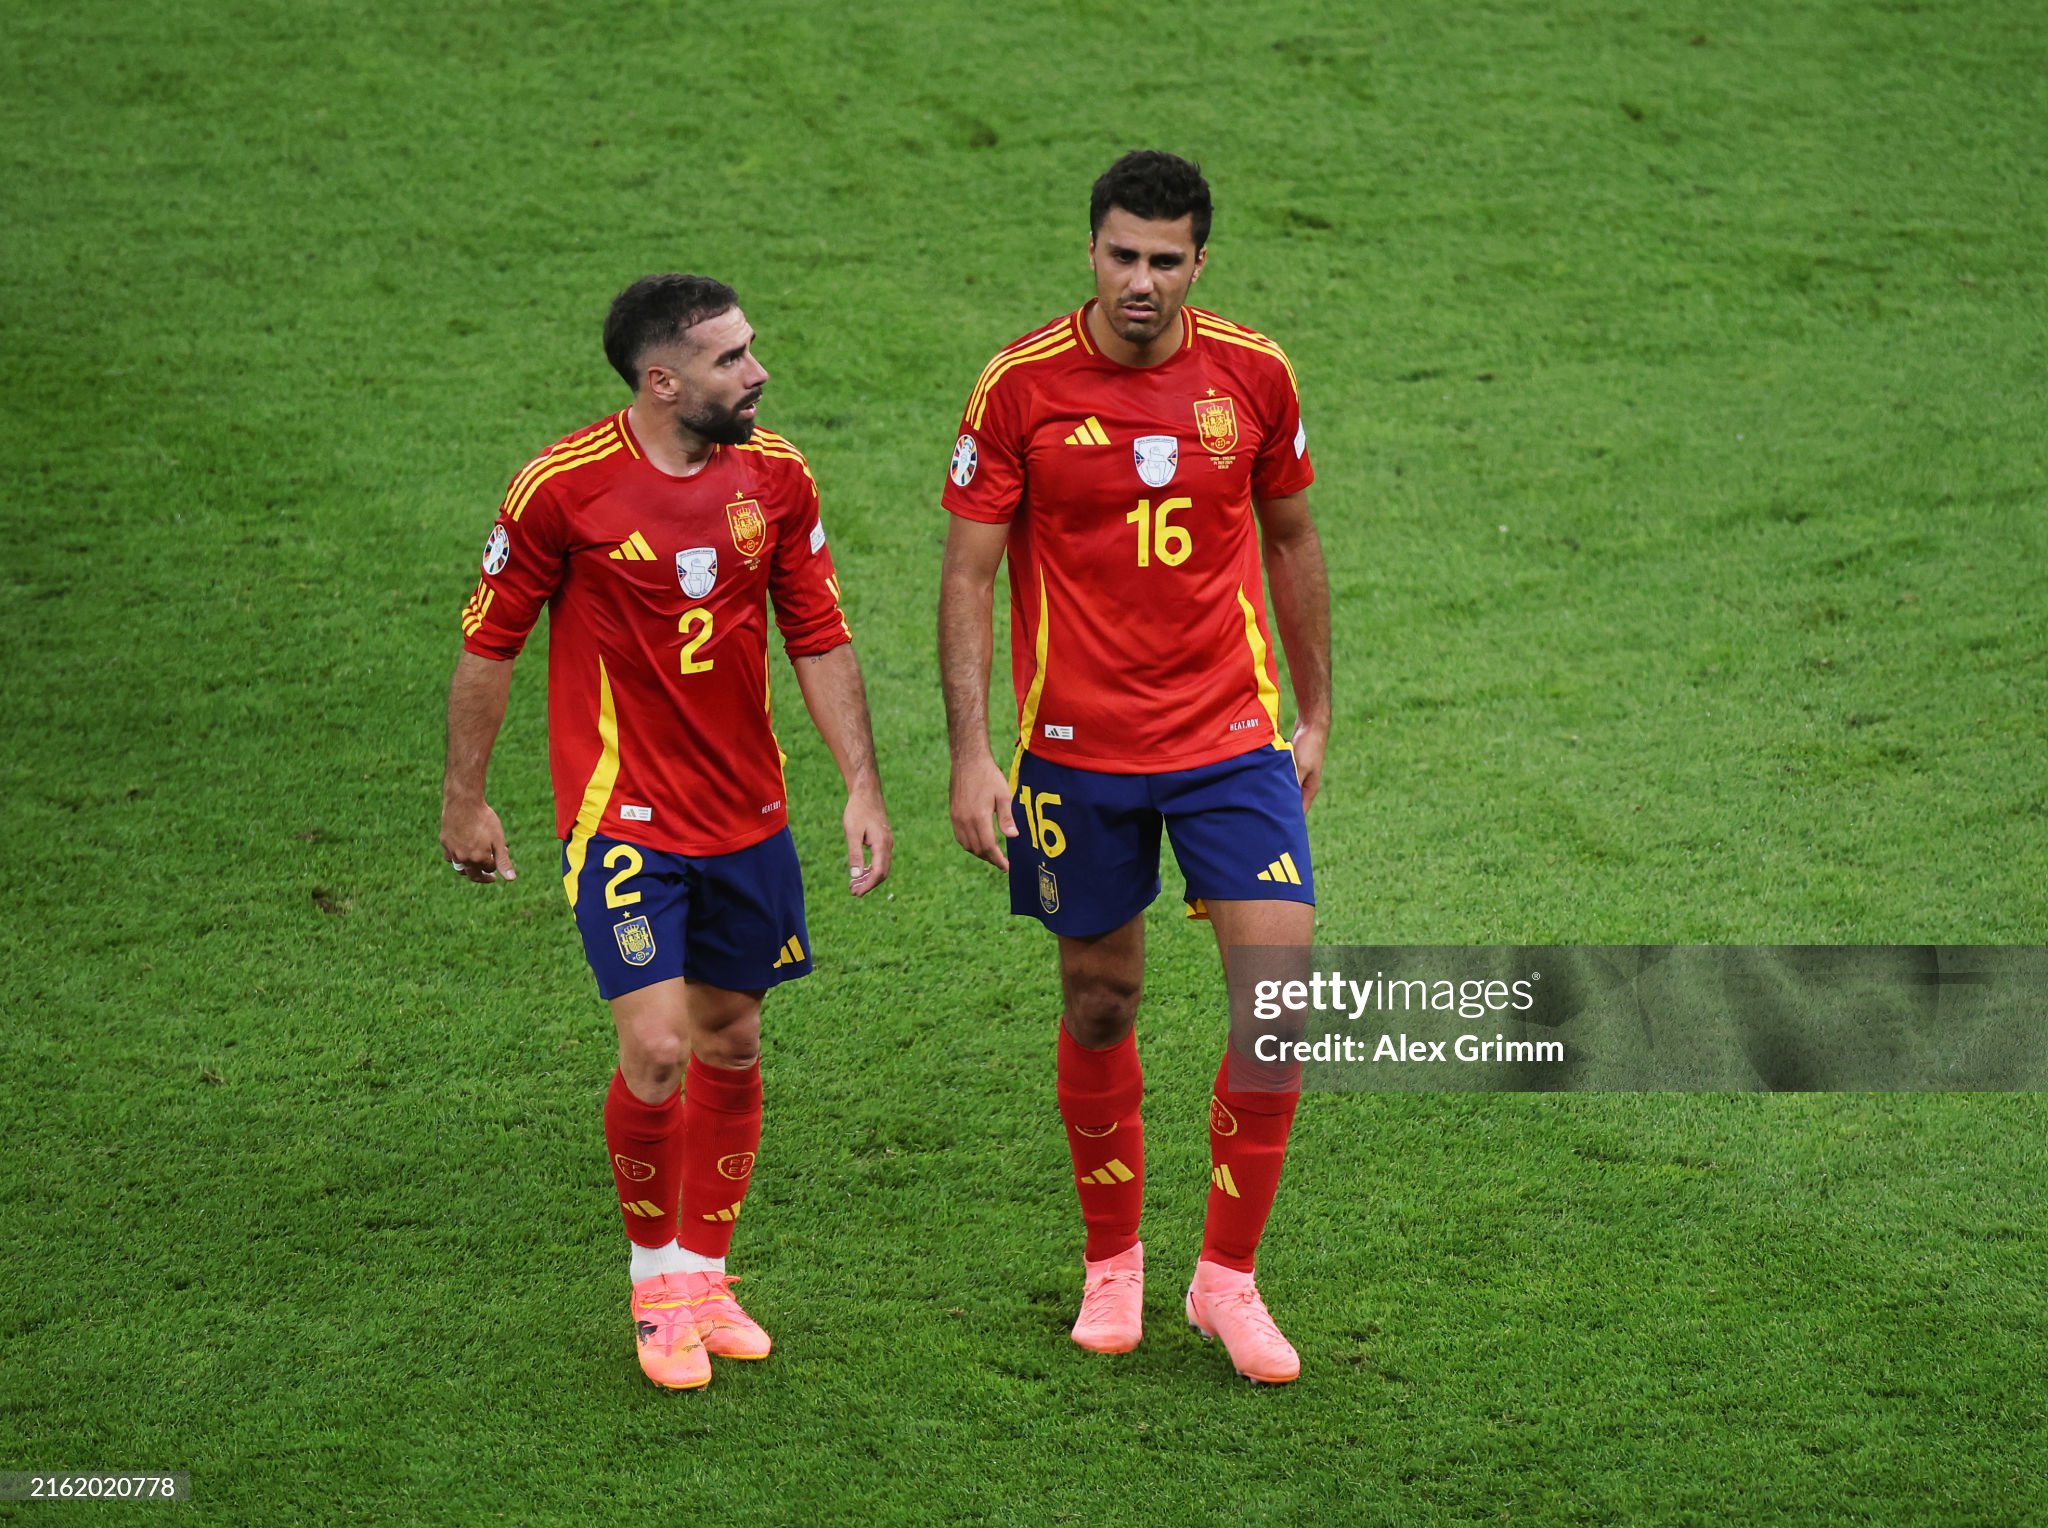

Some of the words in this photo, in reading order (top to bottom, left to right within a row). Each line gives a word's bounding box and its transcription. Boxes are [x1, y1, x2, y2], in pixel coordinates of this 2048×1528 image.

[1126, 497, 1193, 568] 16
[678, 607, 714, 675] 2
[1019, 785, 1067, 858] 16
[603, 844, 643, 909] 2
